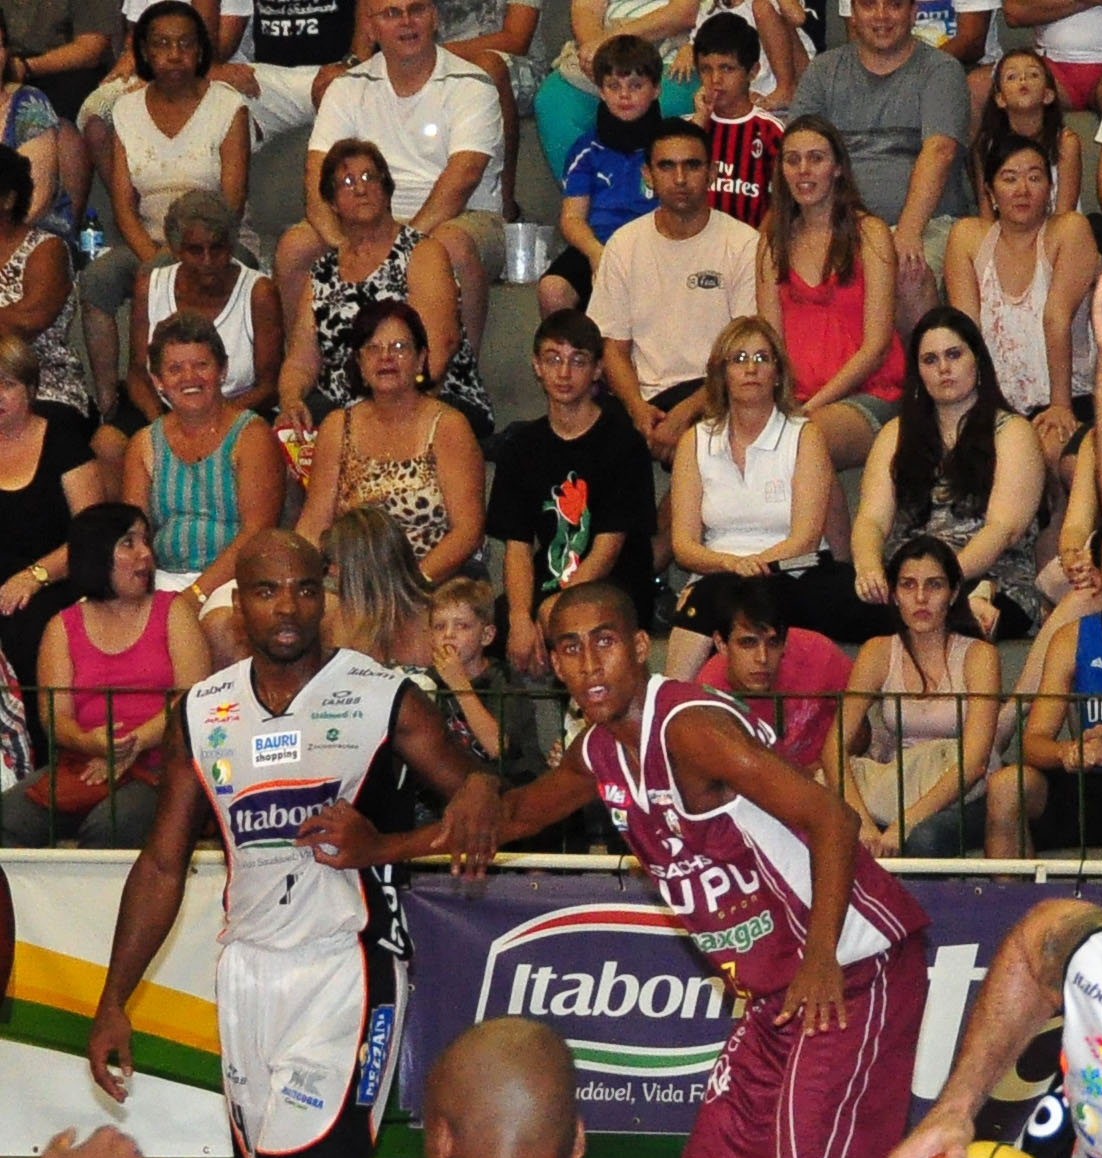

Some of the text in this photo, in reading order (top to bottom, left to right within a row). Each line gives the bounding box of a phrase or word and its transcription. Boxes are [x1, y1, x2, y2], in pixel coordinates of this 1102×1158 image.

[255, 733, 298, 751] BAURU
[255, 748, 298, 762] shopping
[650, 854, 712, 879] SACHS
[507, 960, 747, 1019] Itabom
[642, 1083, 684, 1103] Vida
